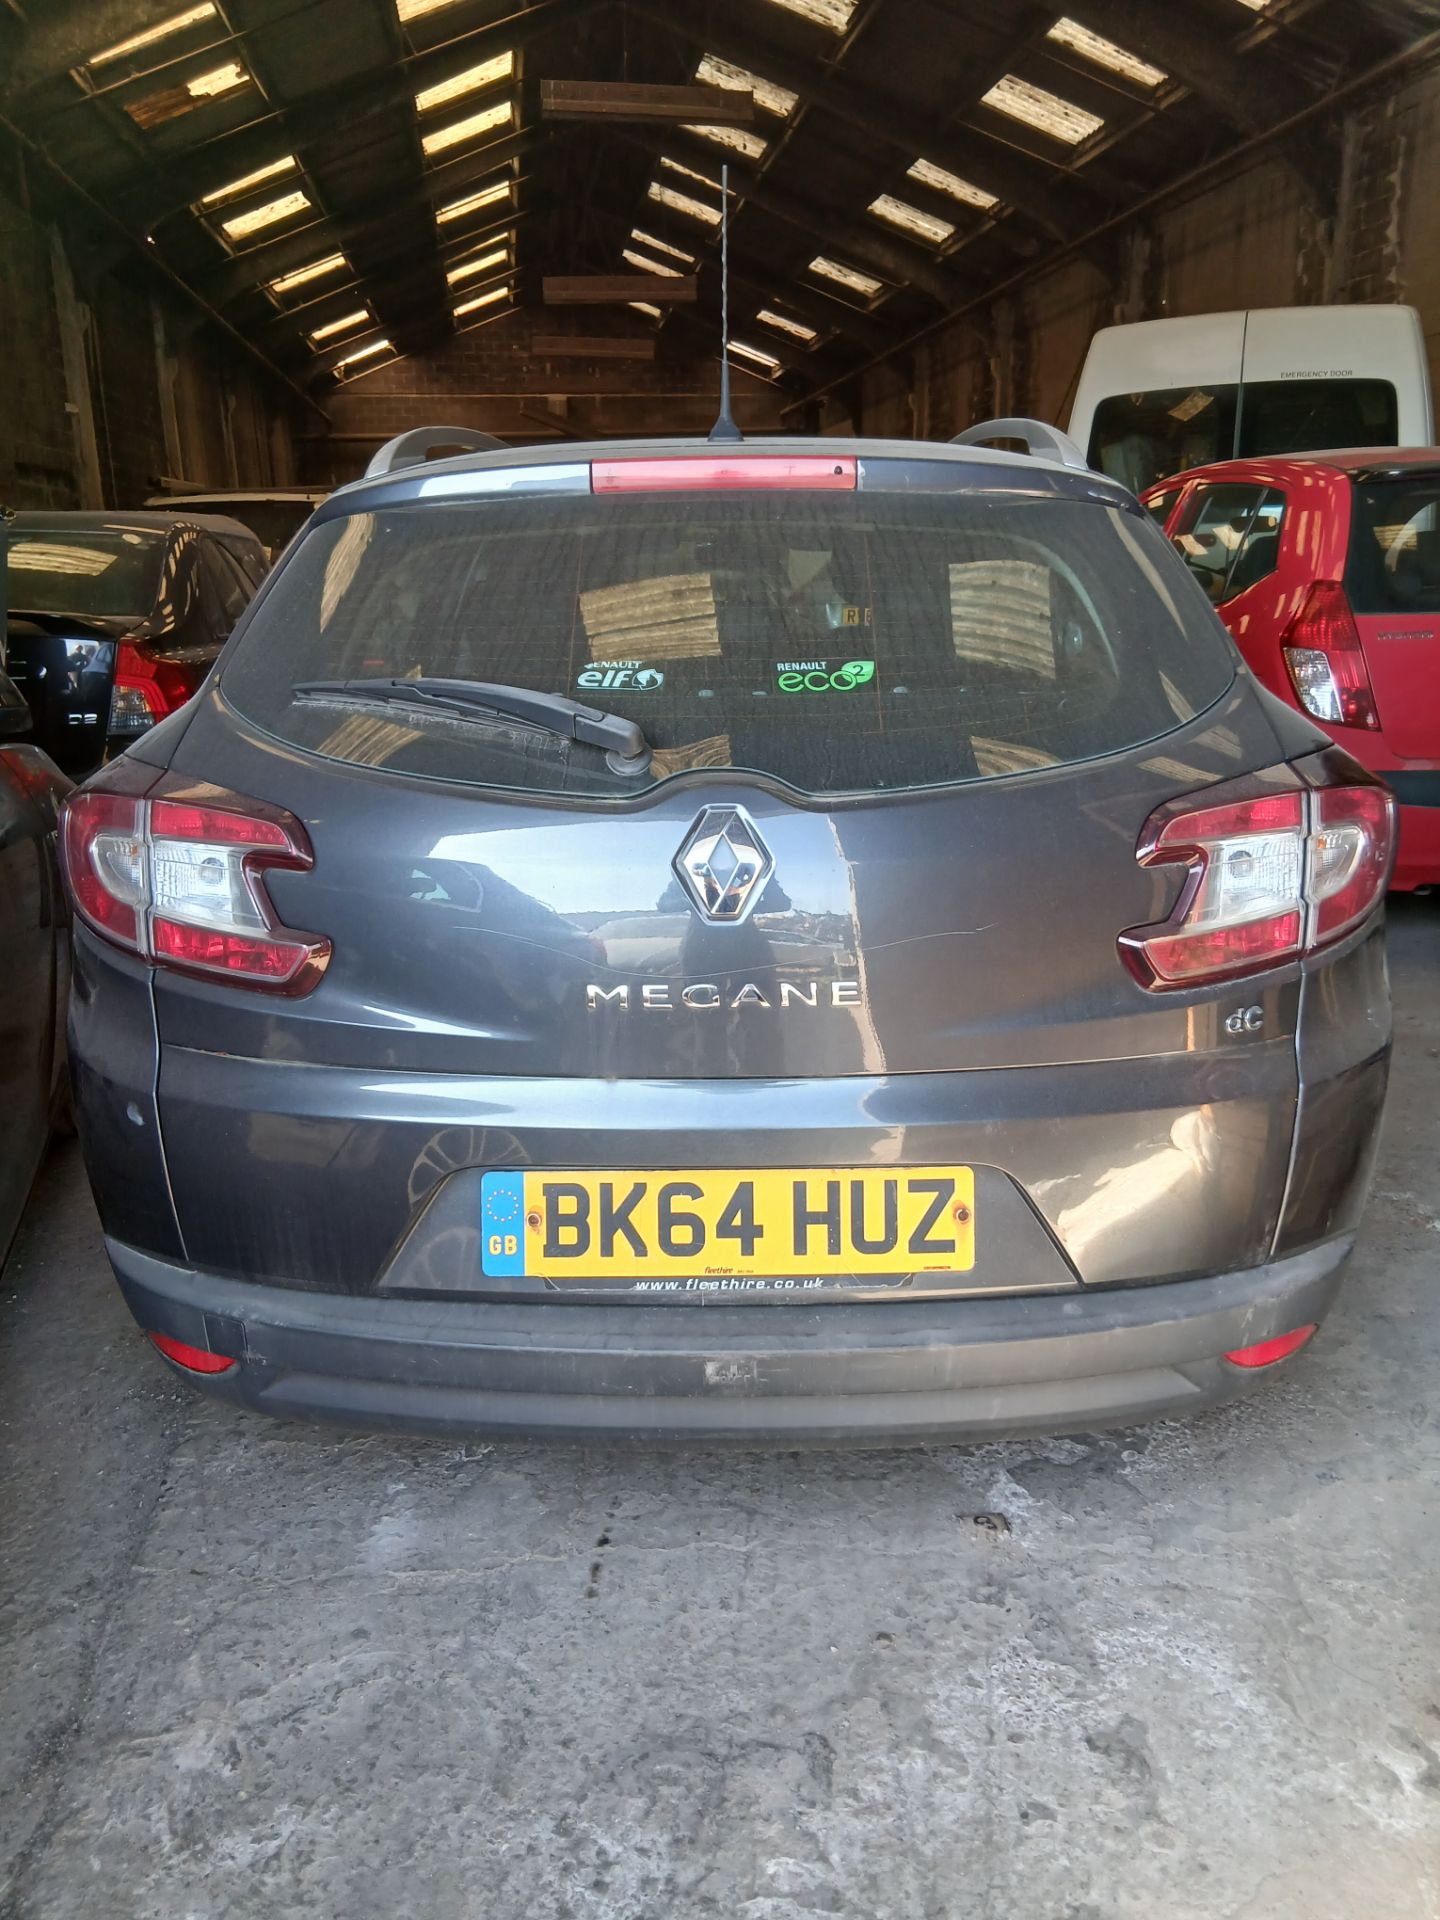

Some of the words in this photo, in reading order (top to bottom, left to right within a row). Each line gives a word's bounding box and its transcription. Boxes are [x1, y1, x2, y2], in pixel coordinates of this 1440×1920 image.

[1280, 371, 1328, 379] EMERGENCY
[777, 661, 827, 671] RENAULT
[577, 670, 633, 687] elf
[586, 982, 862, 1009] MEGANE
[542, 1181, 763, 1258] BK64
[792, 1178, 956, 1258] HUZ
[488, 1234, 518, 1256] GB
[635, 1276, 825, 1292] www.fleethire.co.uk
